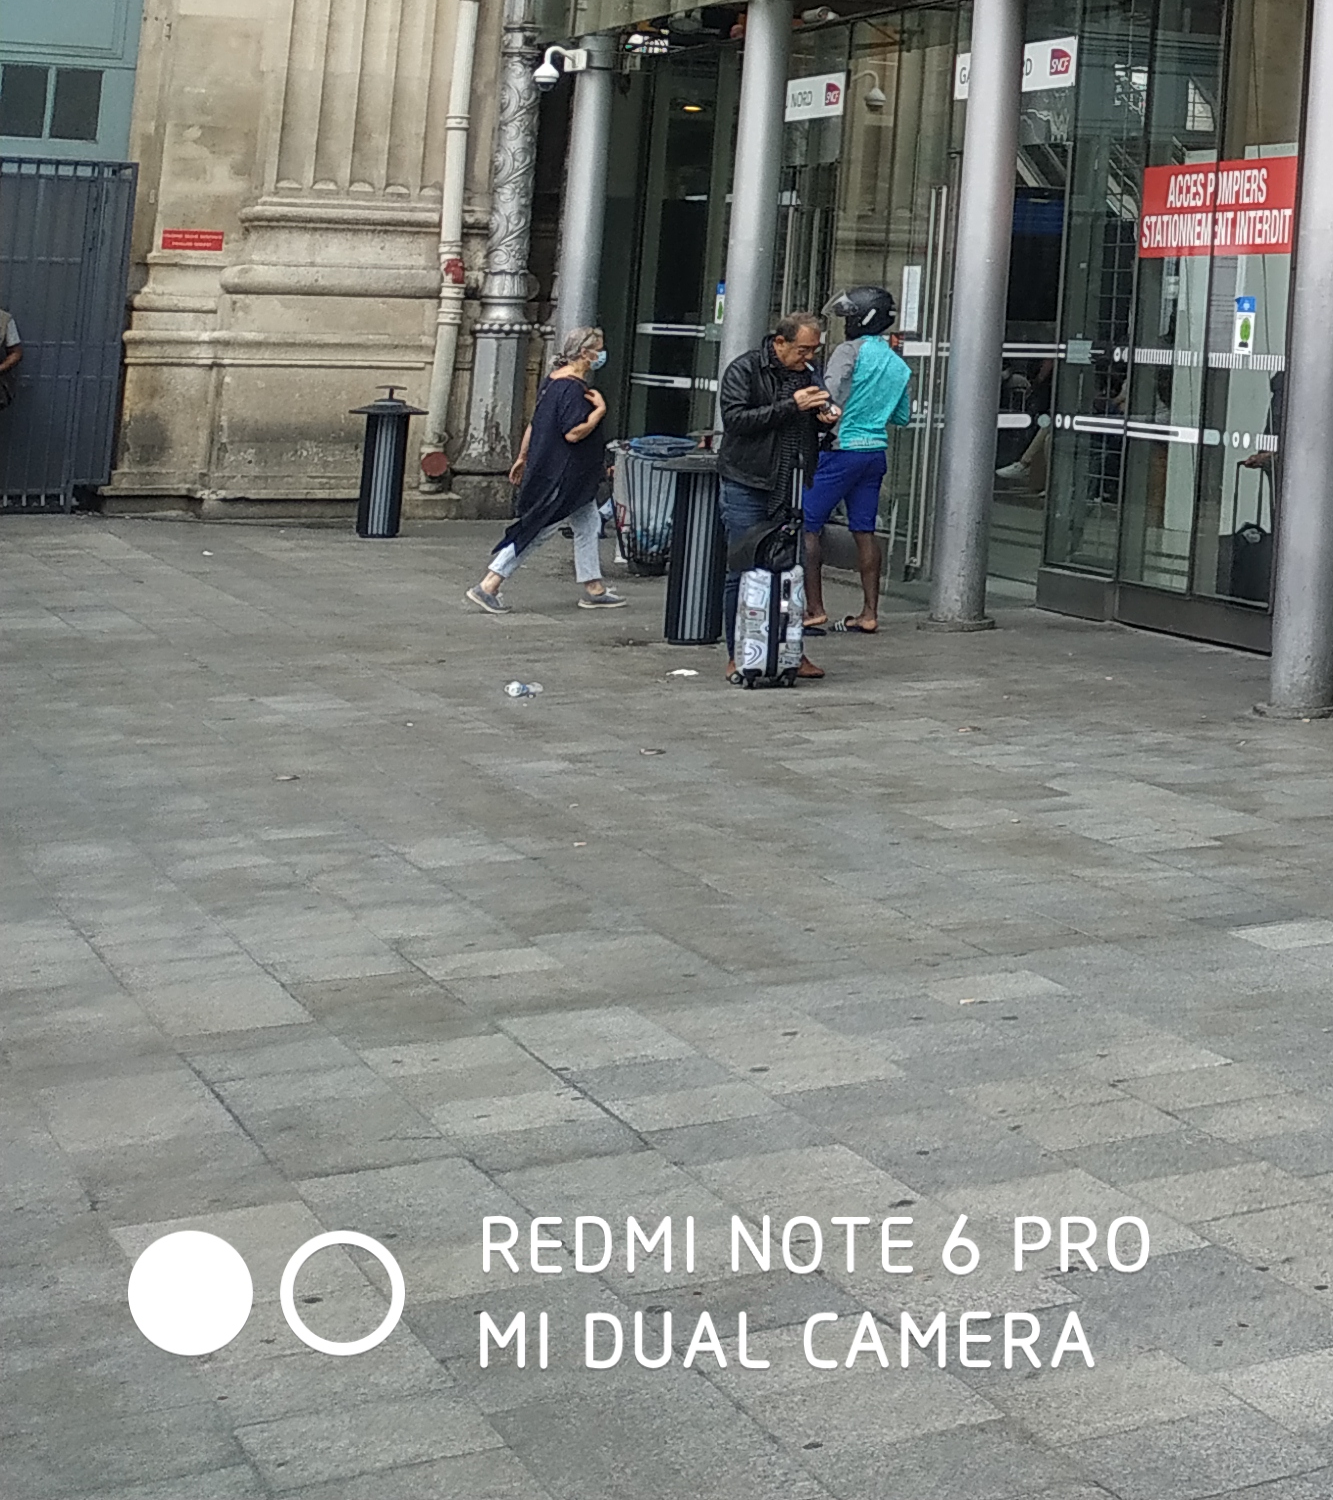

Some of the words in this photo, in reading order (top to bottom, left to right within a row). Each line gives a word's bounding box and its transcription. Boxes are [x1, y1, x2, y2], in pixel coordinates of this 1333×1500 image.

[791, 90, 813, 108] NORD
[1166, 172, 1205, 208] ACCES
[1142, 211, 1234, 248] STATIONNEMENT
[1235, 208, 1293, 245] INTERDIT
